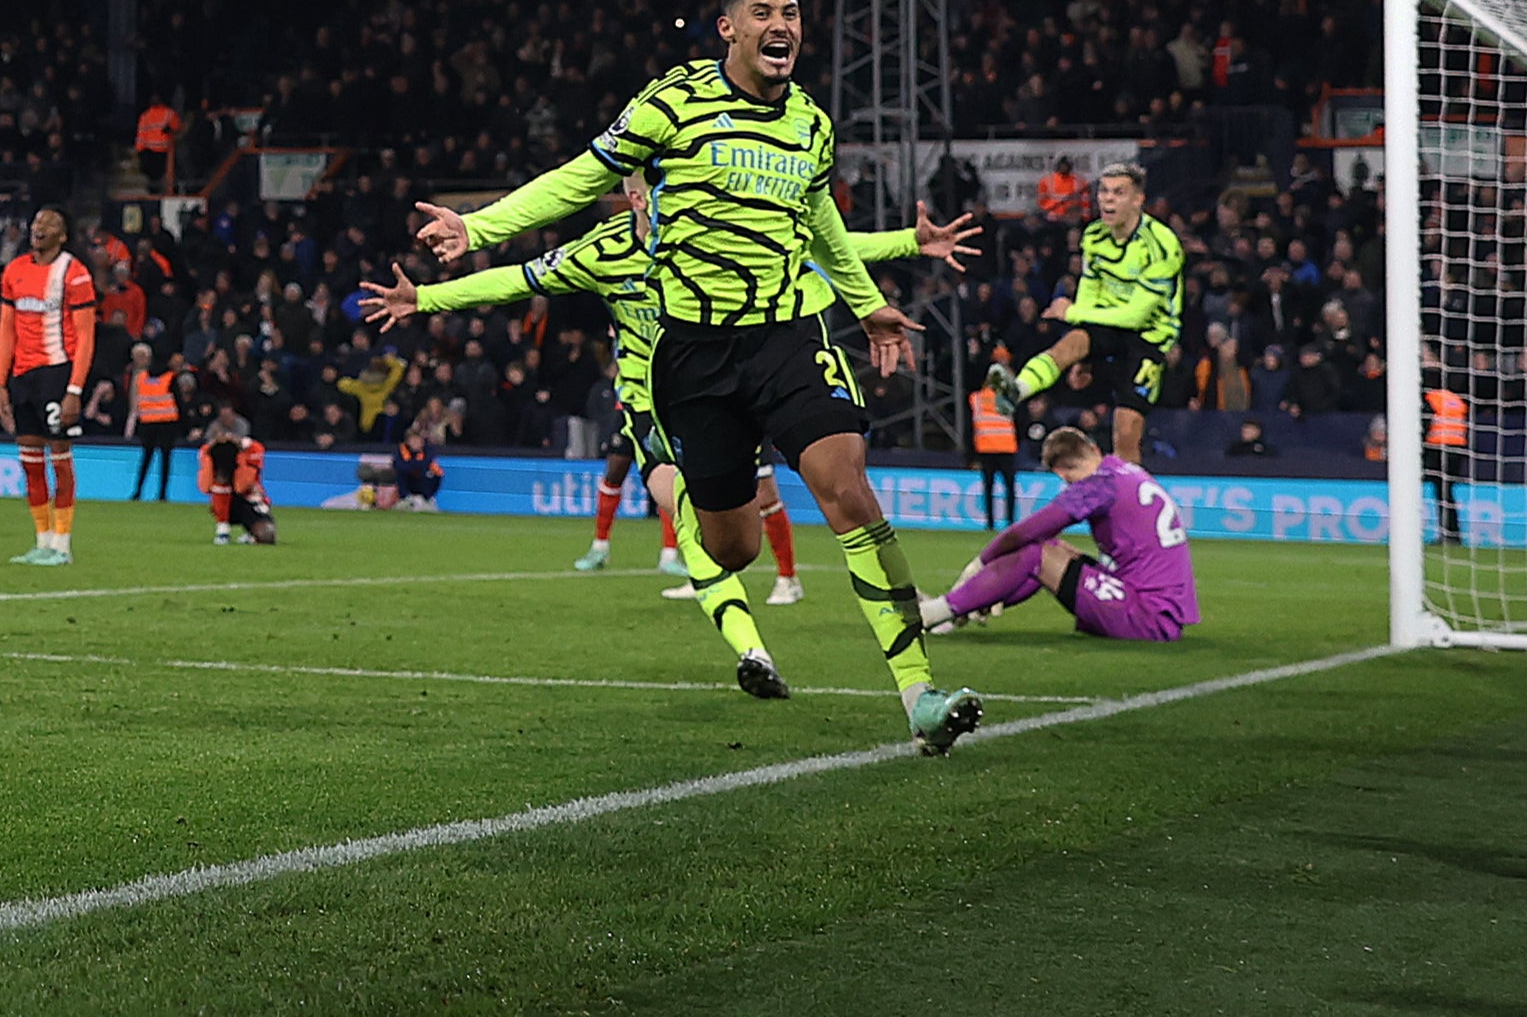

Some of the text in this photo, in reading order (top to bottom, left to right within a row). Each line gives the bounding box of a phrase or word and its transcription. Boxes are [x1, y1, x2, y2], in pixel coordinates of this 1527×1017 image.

[711, 142, 815, 180] Emirates
[728, 172, 801, 200] FLY BETTER
